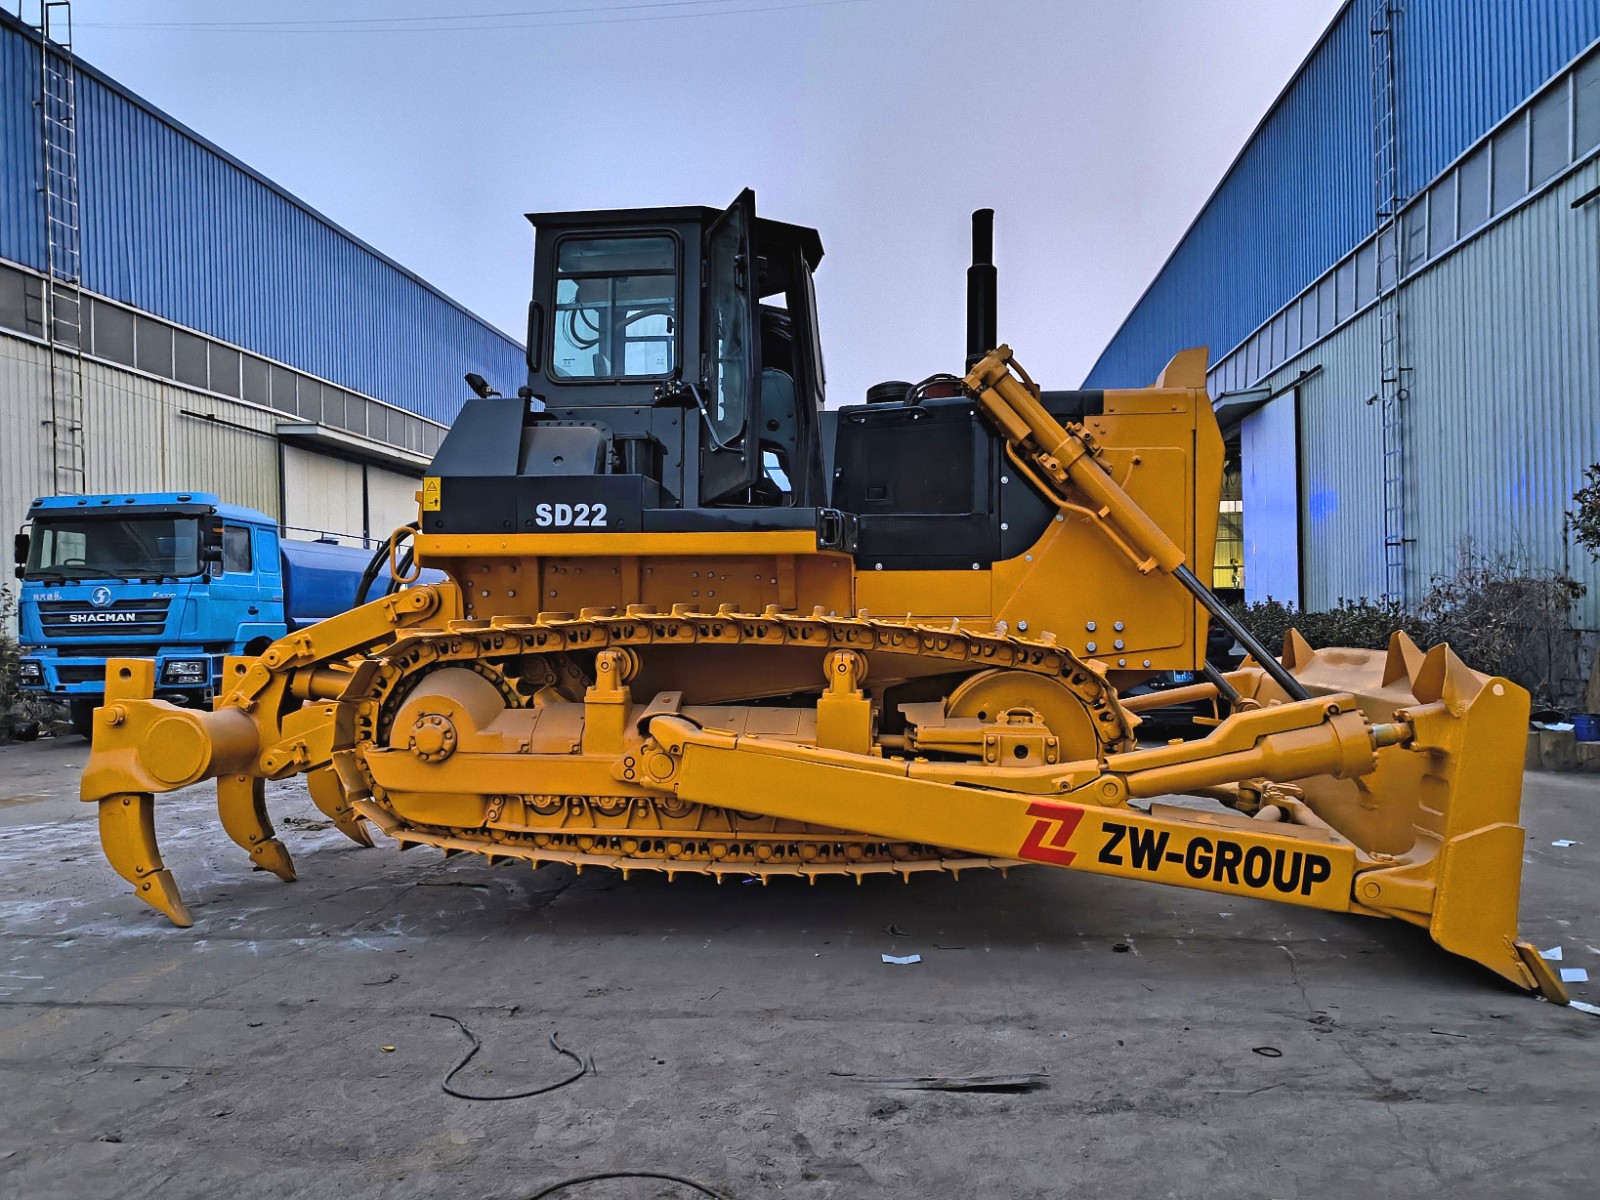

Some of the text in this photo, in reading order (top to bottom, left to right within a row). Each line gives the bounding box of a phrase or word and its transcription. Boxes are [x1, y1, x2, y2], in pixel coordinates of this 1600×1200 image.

[535, 503, 608, 527] SD22
[69, 613, 136, 622] SHACMAN
[1098, 822, 1331, 896] ZW-GROUP
